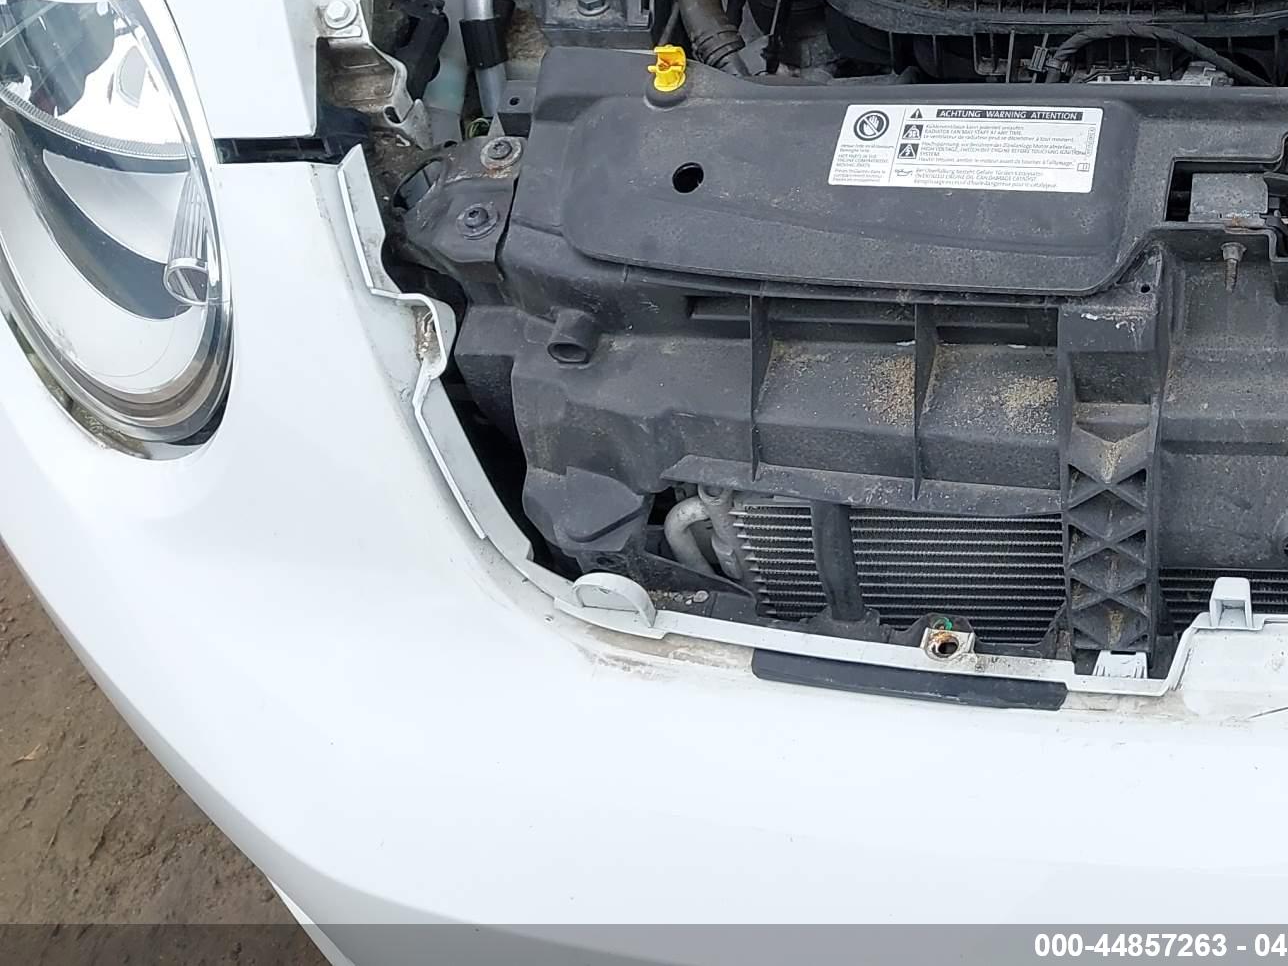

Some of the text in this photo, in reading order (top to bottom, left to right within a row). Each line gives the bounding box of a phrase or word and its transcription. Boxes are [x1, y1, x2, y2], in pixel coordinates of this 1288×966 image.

[939, 110, 1078, 120] ACHTUNG WARNING ATTENTION
